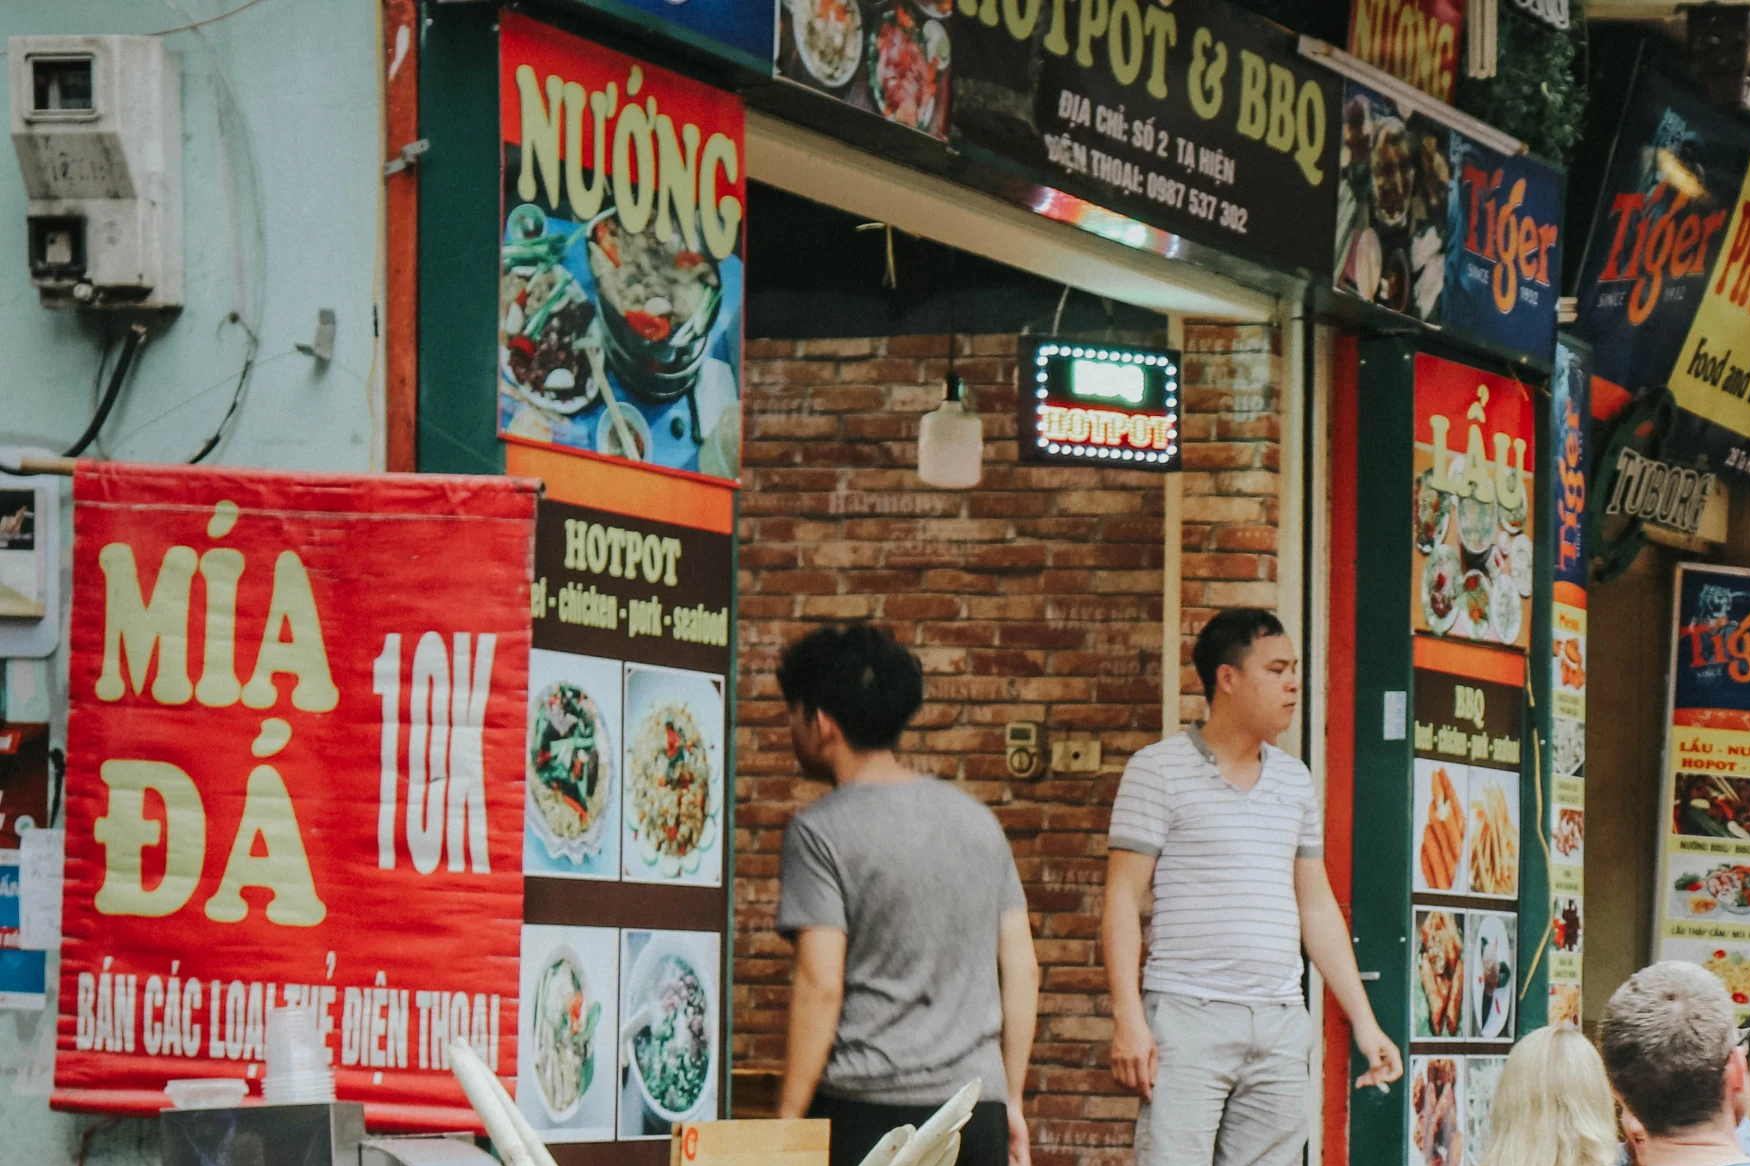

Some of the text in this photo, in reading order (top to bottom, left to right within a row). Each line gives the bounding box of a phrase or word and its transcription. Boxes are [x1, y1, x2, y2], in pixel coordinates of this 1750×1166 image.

[958, 0, 1326, 186] TPOT & BBQ
[1058, 90, 1091, 128] ĐỊA
[1132, 116, 1157, 151] SỐ
[1156, 131, 1169, 157] 2
[1176, 137, 1195, 174] TẠ
[1198, 149, 1236, 185] HIỆN
[515, 64, 742, 260] NƯỚNG
[1146, 172, 1186, 209] 0987
[1189, 188, 1217, 220] 537
[1462, 163, 1557, 314] Tiger
[1598, 181, 1727, 325] Tiger
[1687, 337, 1731, 387] Food
[1042, 405, 1172, 450] HOTPOT
[1430, 384, 1527, 510] LẨU
[1558, 396, 1586, 572] Tiger
[1606, 446, 1717, 534] TUBORG
[97, 500, 340, 713] MÍA
[531, 577, 728, 647] ef chicken pork seafood
[564, 518, 682, 587] HOTPOT
[372, 630, 498, 875] 10K
[1454, 684, 1485, 730] BBQ
[1681, 758, 1738, 772] HOPOT
[94, 718, 328, 927] ĐÁ
[76, 955, 137, 1053] BÁN
[143, 959, 202, 1056] CÁC
[341, 970, 409, 1085] ĐIỆN
